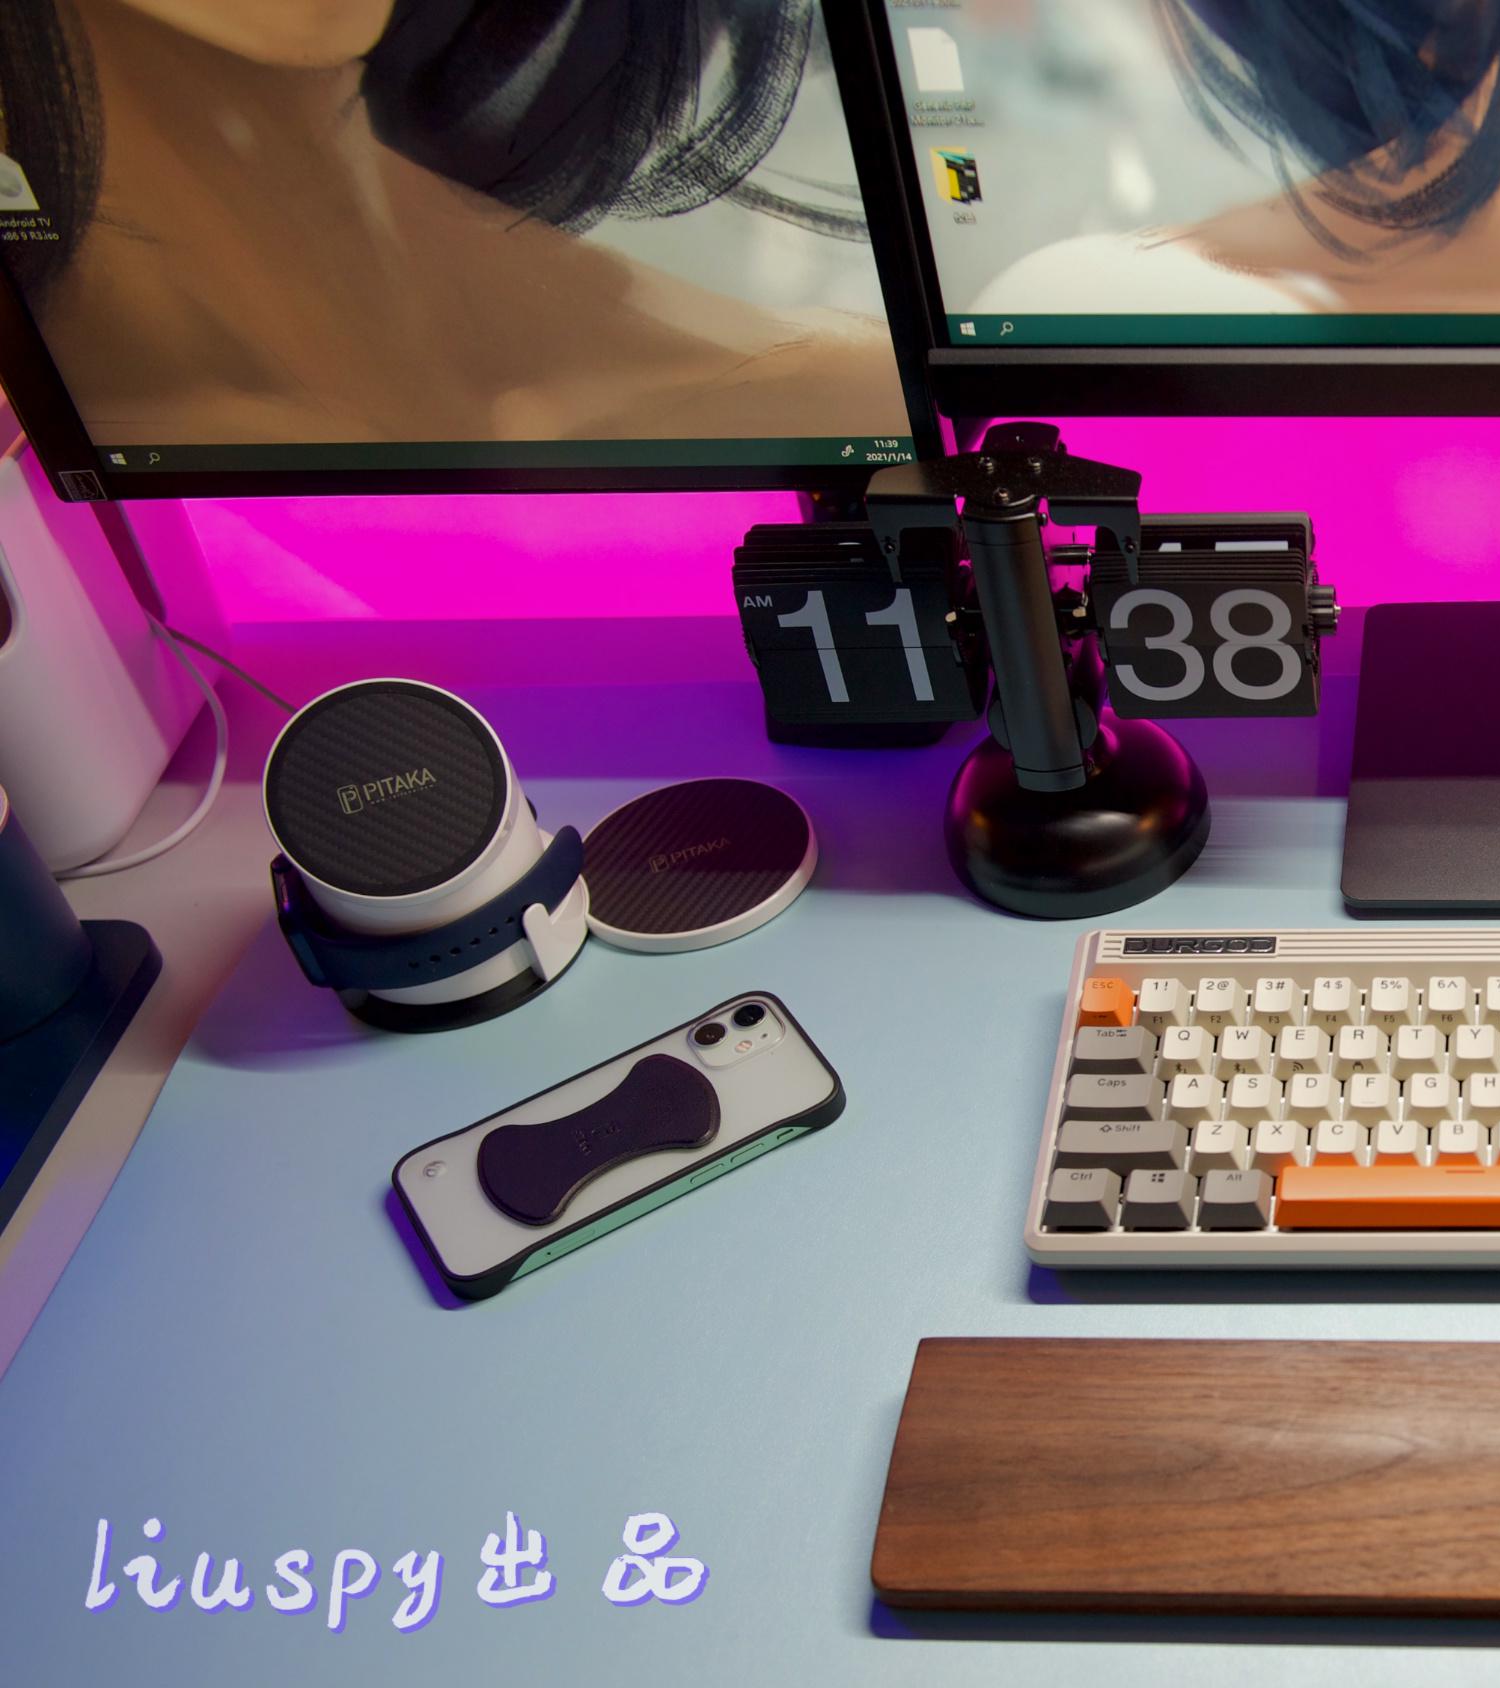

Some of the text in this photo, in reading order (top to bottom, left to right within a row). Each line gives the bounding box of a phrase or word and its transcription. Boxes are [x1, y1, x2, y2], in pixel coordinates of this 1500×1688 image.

[0, 217, 51, 228] ndroid TV
[873, 439, 899, 449] 11:39
[865, 452, 913, 462] 2021/1/14
[743, 594, 773, 608] AM
[778, 587, 935, 703] 11
[1109, 587, 1302, 701] 38
[362, 767, 437, 801] PITAKA
[669, 836, 732, 864] PITAKA
[1124, 938, 1276, 954] DURGOD
[1092, 980, 1114, 990] ESC
[1210, 1015, 1222, 1024] F2
[1325, 1014, 1338, 1023] F4
[1096, 1029, 1115, 1038] Tab
[1178, 1029, 1191, 1041] Q
[1235, 1029, 1250, 1040] W
[1295, 1029, 1305, 1040] E
[1353, 1029, 1365, 1040] R
[1412, 1028, 1423, 1040] T
[1470, 1028, 1482, 1040] Y
[1097, 1077, 1127, 1088] Caps
[1187, 1078, 1200, 1089] A
[1247, 1077, 1259, 1089] S
[1305, 1077, 1318, 1089] D
[1365, 1077, 1376, 1088] F
[1424, 1076, 1438, 1089] G
[1485, 1077, 1497, 1088] H
[1114, 1123, 1141, 1133] Shift
[1211, 1124, 1223, 1135] Z
[1271, 1124, 1283, 1135] X
[1330, 1124, 1344, 1135] C
[1392, 1124, 1404, 1135] V
[1453, 1124, 1465, 1135] B
[1070, 1172, 1094, 1182] Ctrl
[1226, 1172, 1243, 1182] Alt
